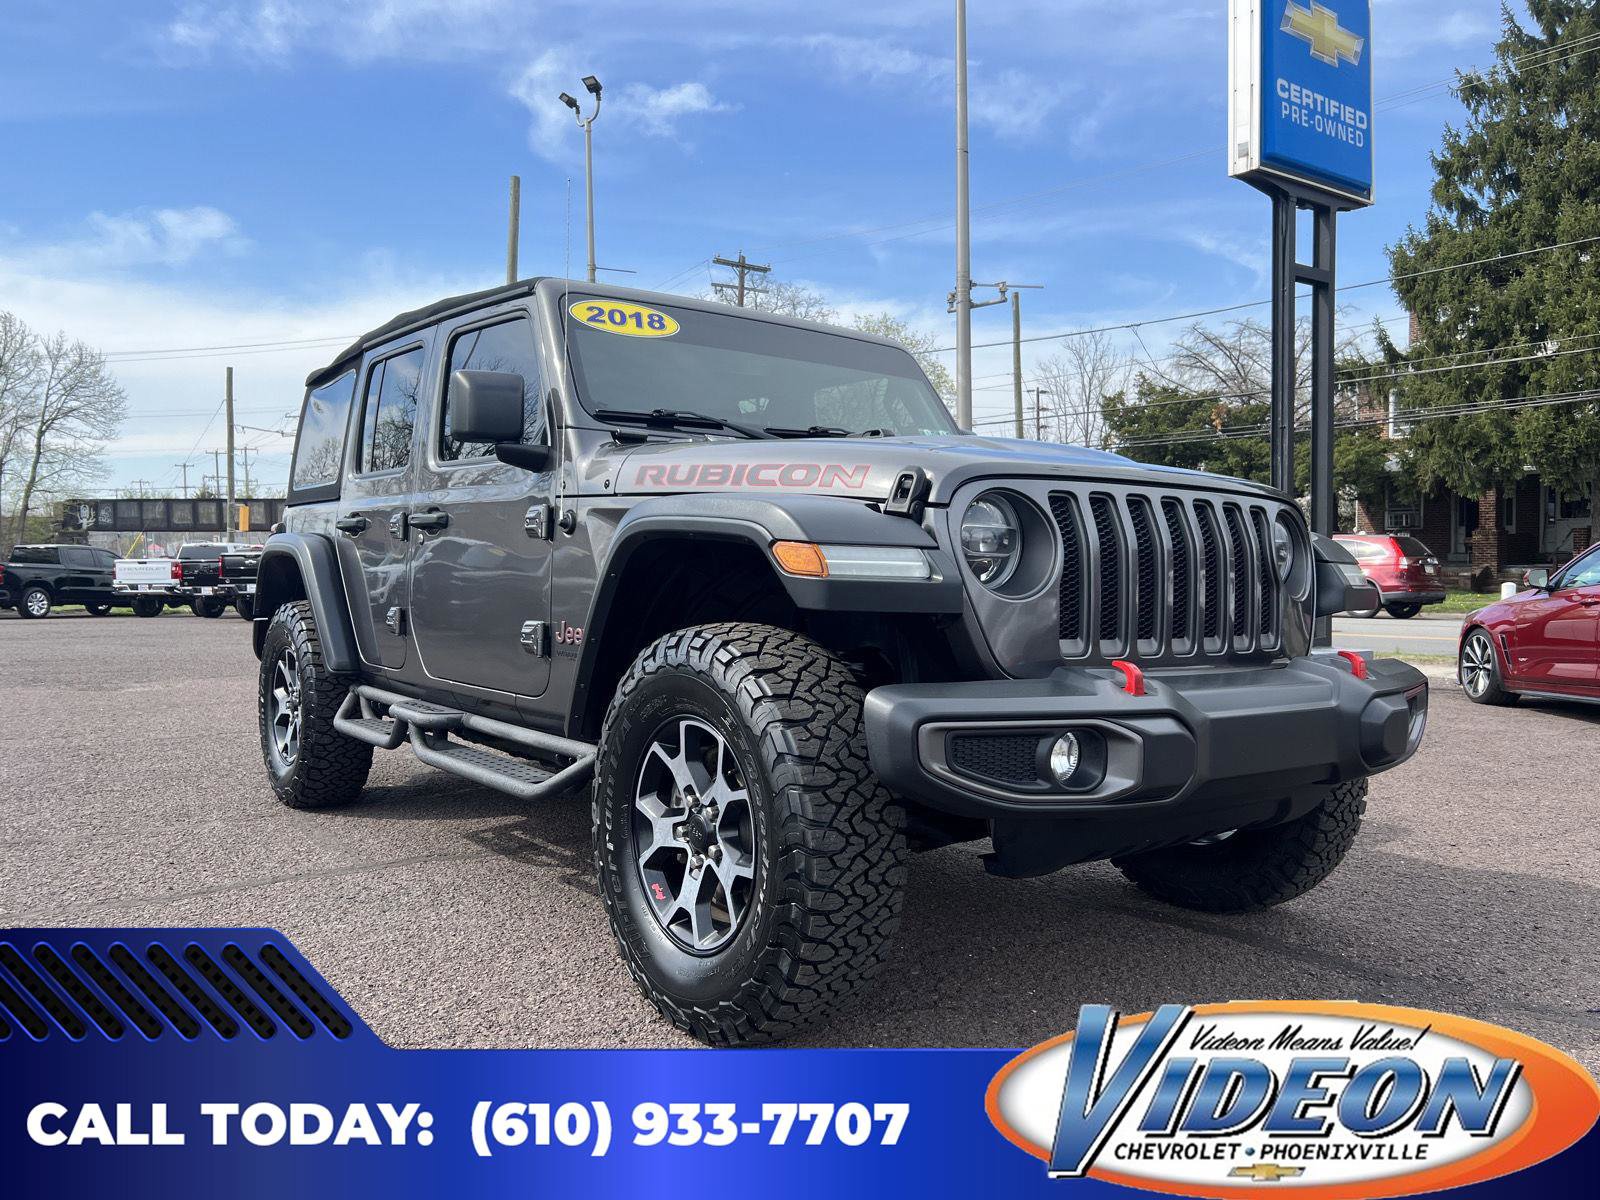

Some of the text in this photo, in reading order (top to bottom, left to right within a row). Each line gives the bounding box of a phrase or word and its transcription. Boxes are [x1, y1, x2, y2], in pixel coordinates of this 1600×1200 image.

[1276, 77, 1368, 130] CERTIFIED
[1281, 101, 1364, 148] PRE-OWNED
[586, 306, 667, 330] 2018
[634, 463, 871, 489] RUBICON
[555, 620, 585, 646] Jee
